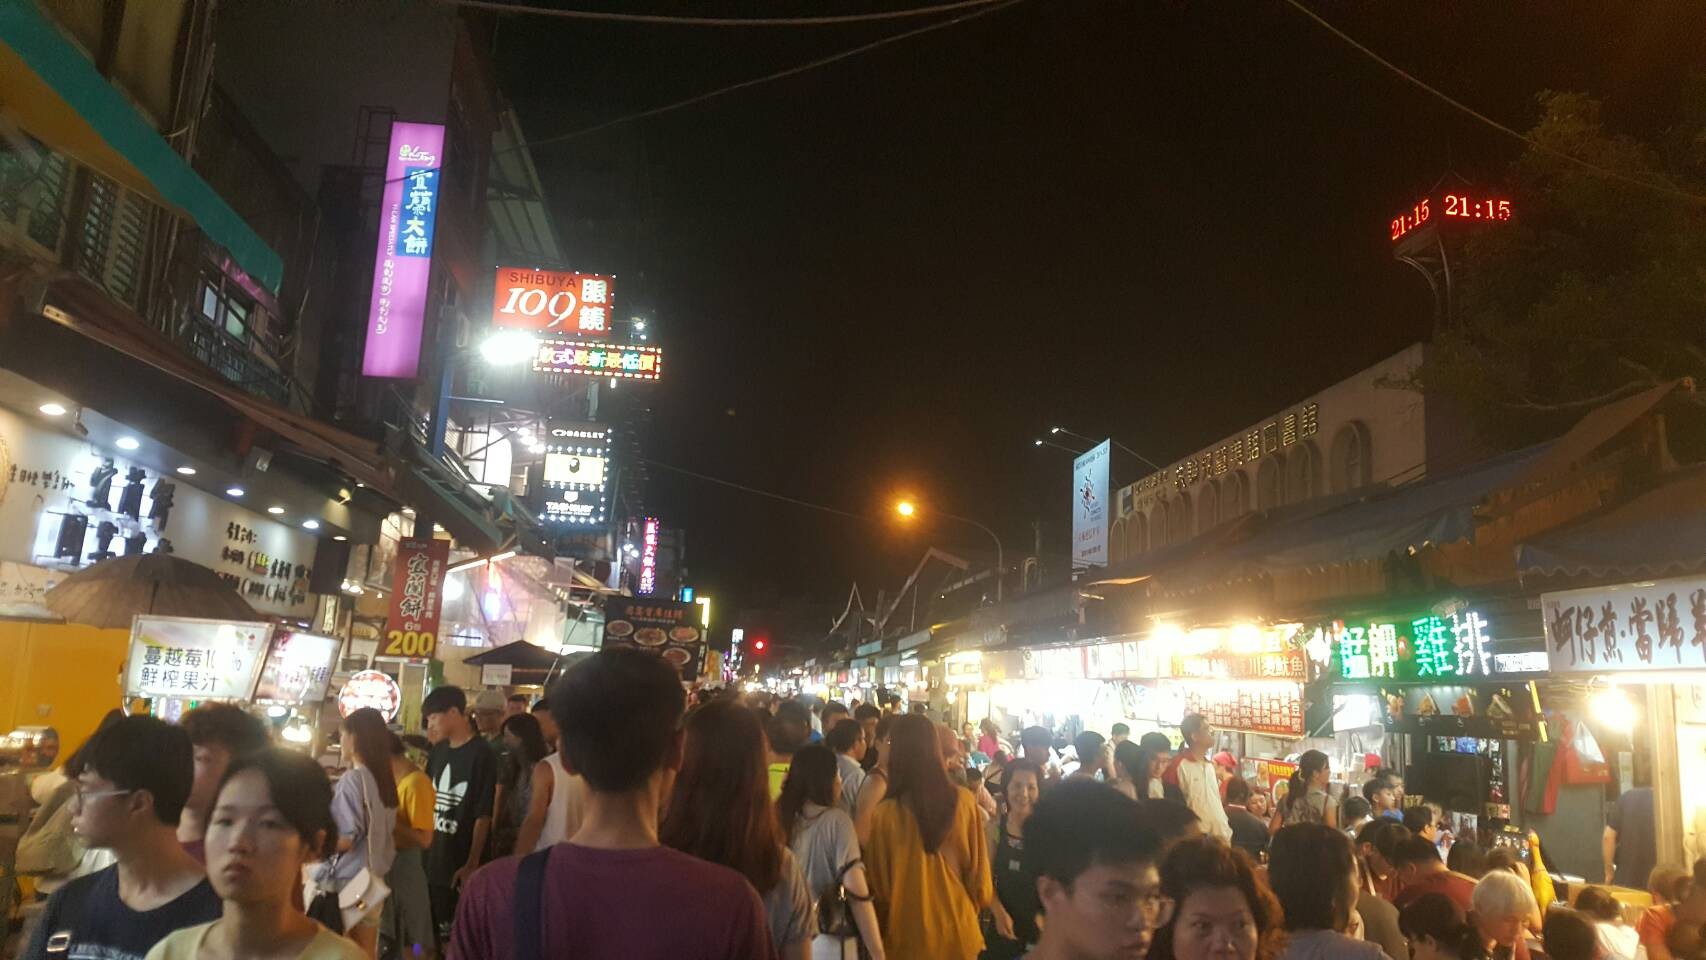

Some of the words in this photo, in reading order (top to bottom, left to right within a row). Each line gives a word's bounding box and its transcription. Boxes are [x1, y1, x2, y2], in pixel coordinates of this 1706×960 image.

[402, 170, 433, 254] 宜蘭大餅
[1392, 199, 1430, 240] 21:15
[1445, 195, 1511, 220] 21:15
[509, 271, 577, 288] SHIBUYA
[500, 287, 577, 328] 109
[579, 278, 608, 331] 眼鏡
[400, 552, 430, 621] 宜蘭餅
[385, 629, 434, 656] 200
[140, 666, 219, 693] 鮮榨果汁
